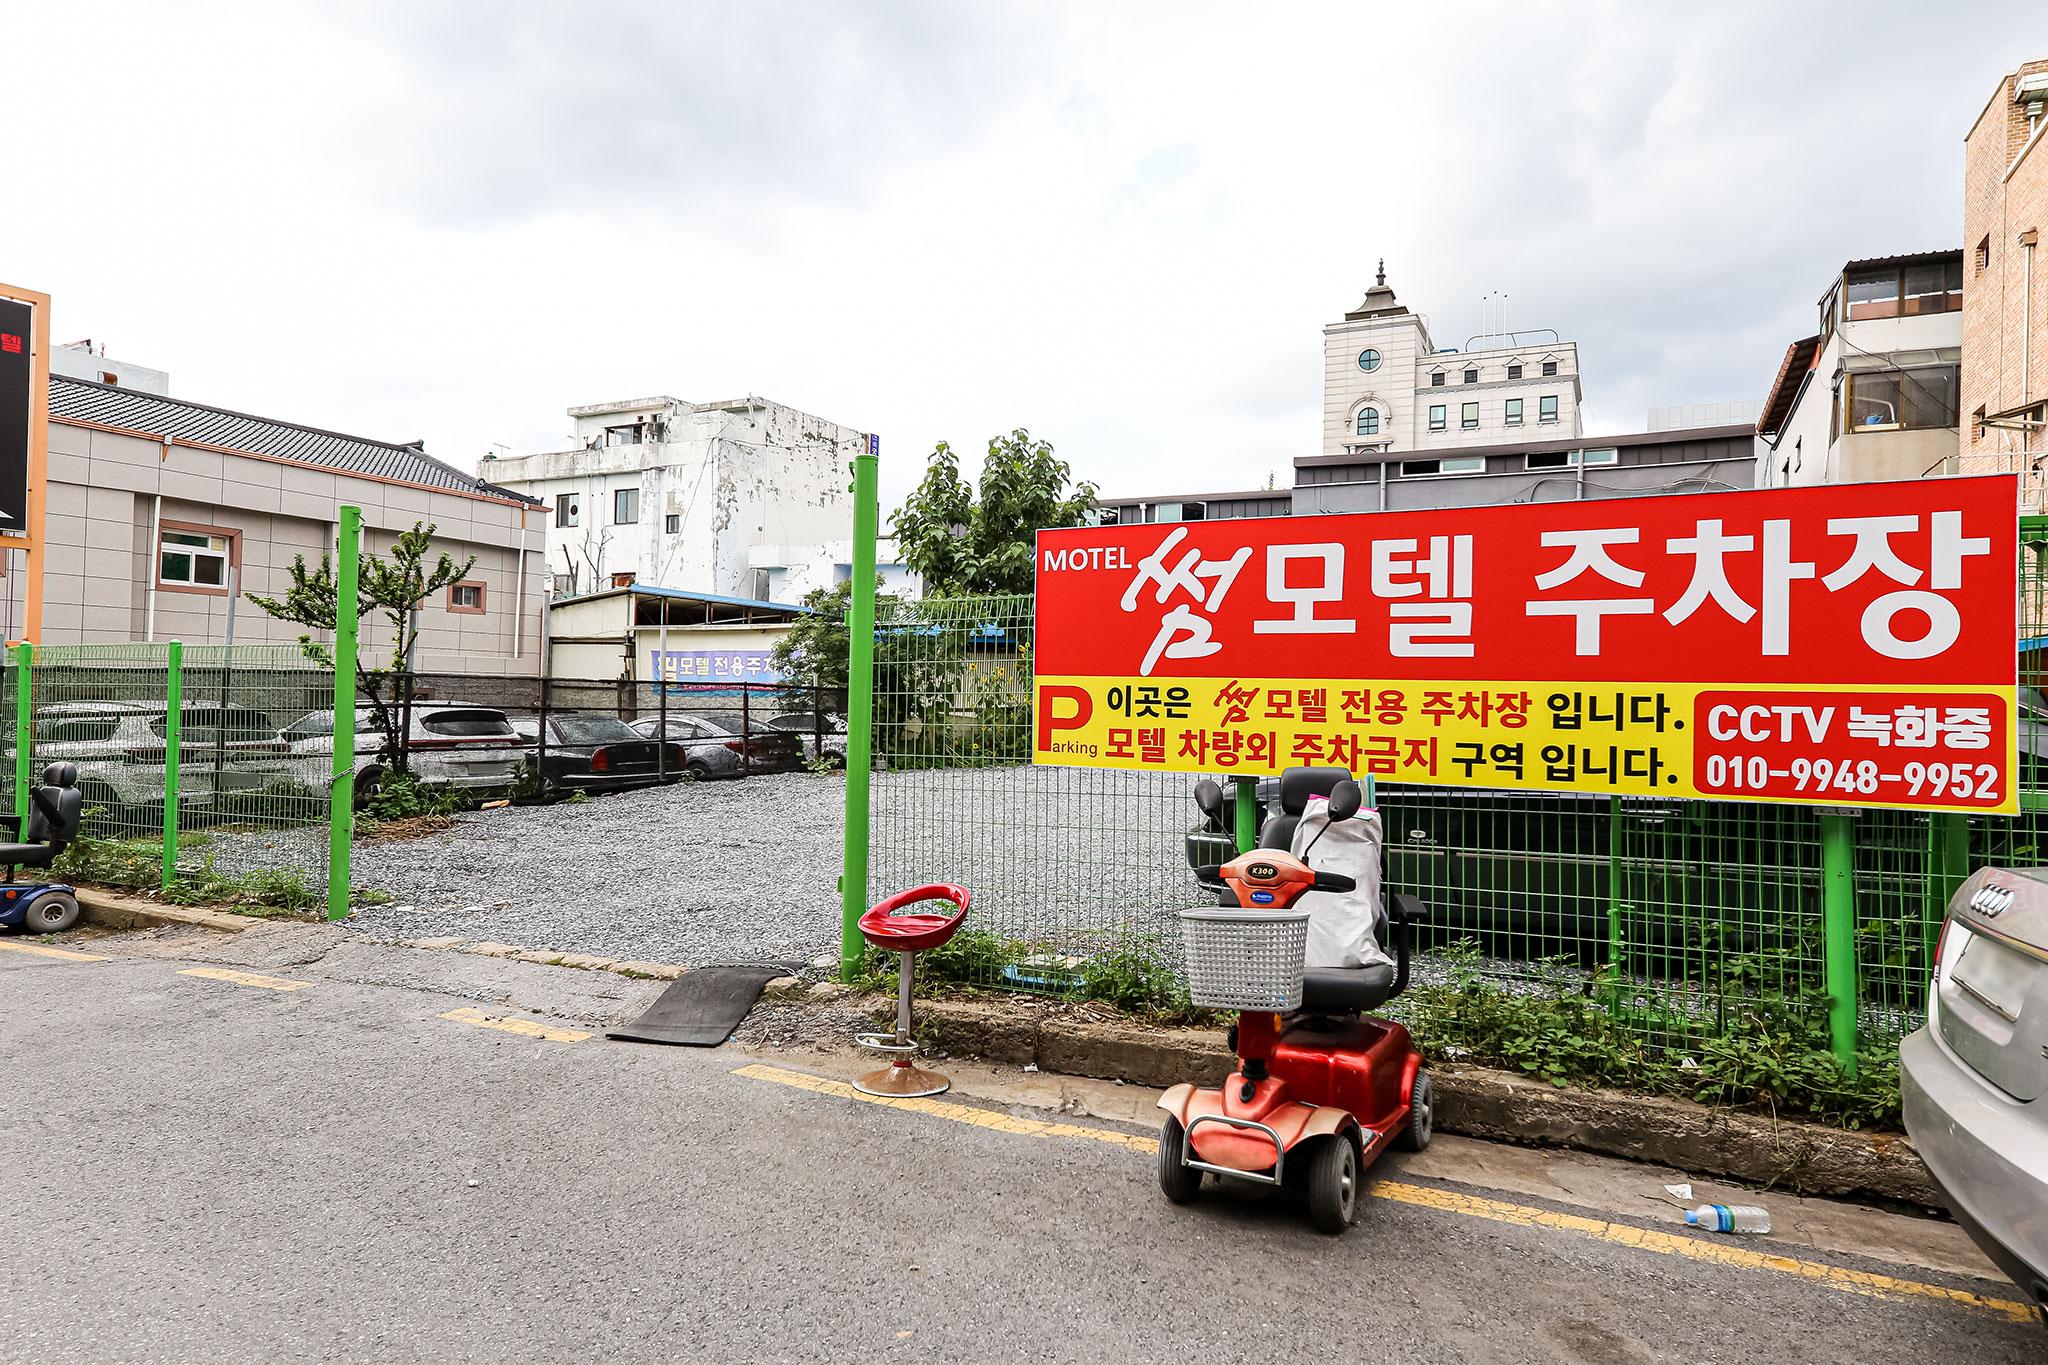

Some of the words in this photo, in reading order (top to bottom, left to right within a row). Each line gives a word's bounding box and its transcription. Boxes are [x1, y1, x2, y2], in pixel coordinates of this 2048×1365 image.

[1044, 546, 1132, 572] MOTEL
[1526, 511, 1990, 660] 주차장
[1107, 685, 1192, 719] 이곳은
[1340, 689, 1408, 725] 전용
[1420, 691, 1532, 728] 주차장
[1547, 692, 1685, 733] 입니다.
[1707, 704, 1835, 744] CCTV
[1847, 705, 1991, 749] 녹화중
[1105, 728, 1166, 763] 모텔
[1177, 729, 1276, 769] 차량외
[1290, 733, 1438, 777] 주차금지
[1451, 742, 1524, 781] 구역
[1540, 744, 1678, 787] 입니다.
[1706, 754, 1998, 799] 010-9948-9952
[1252, 867, 1274, 875] K300
